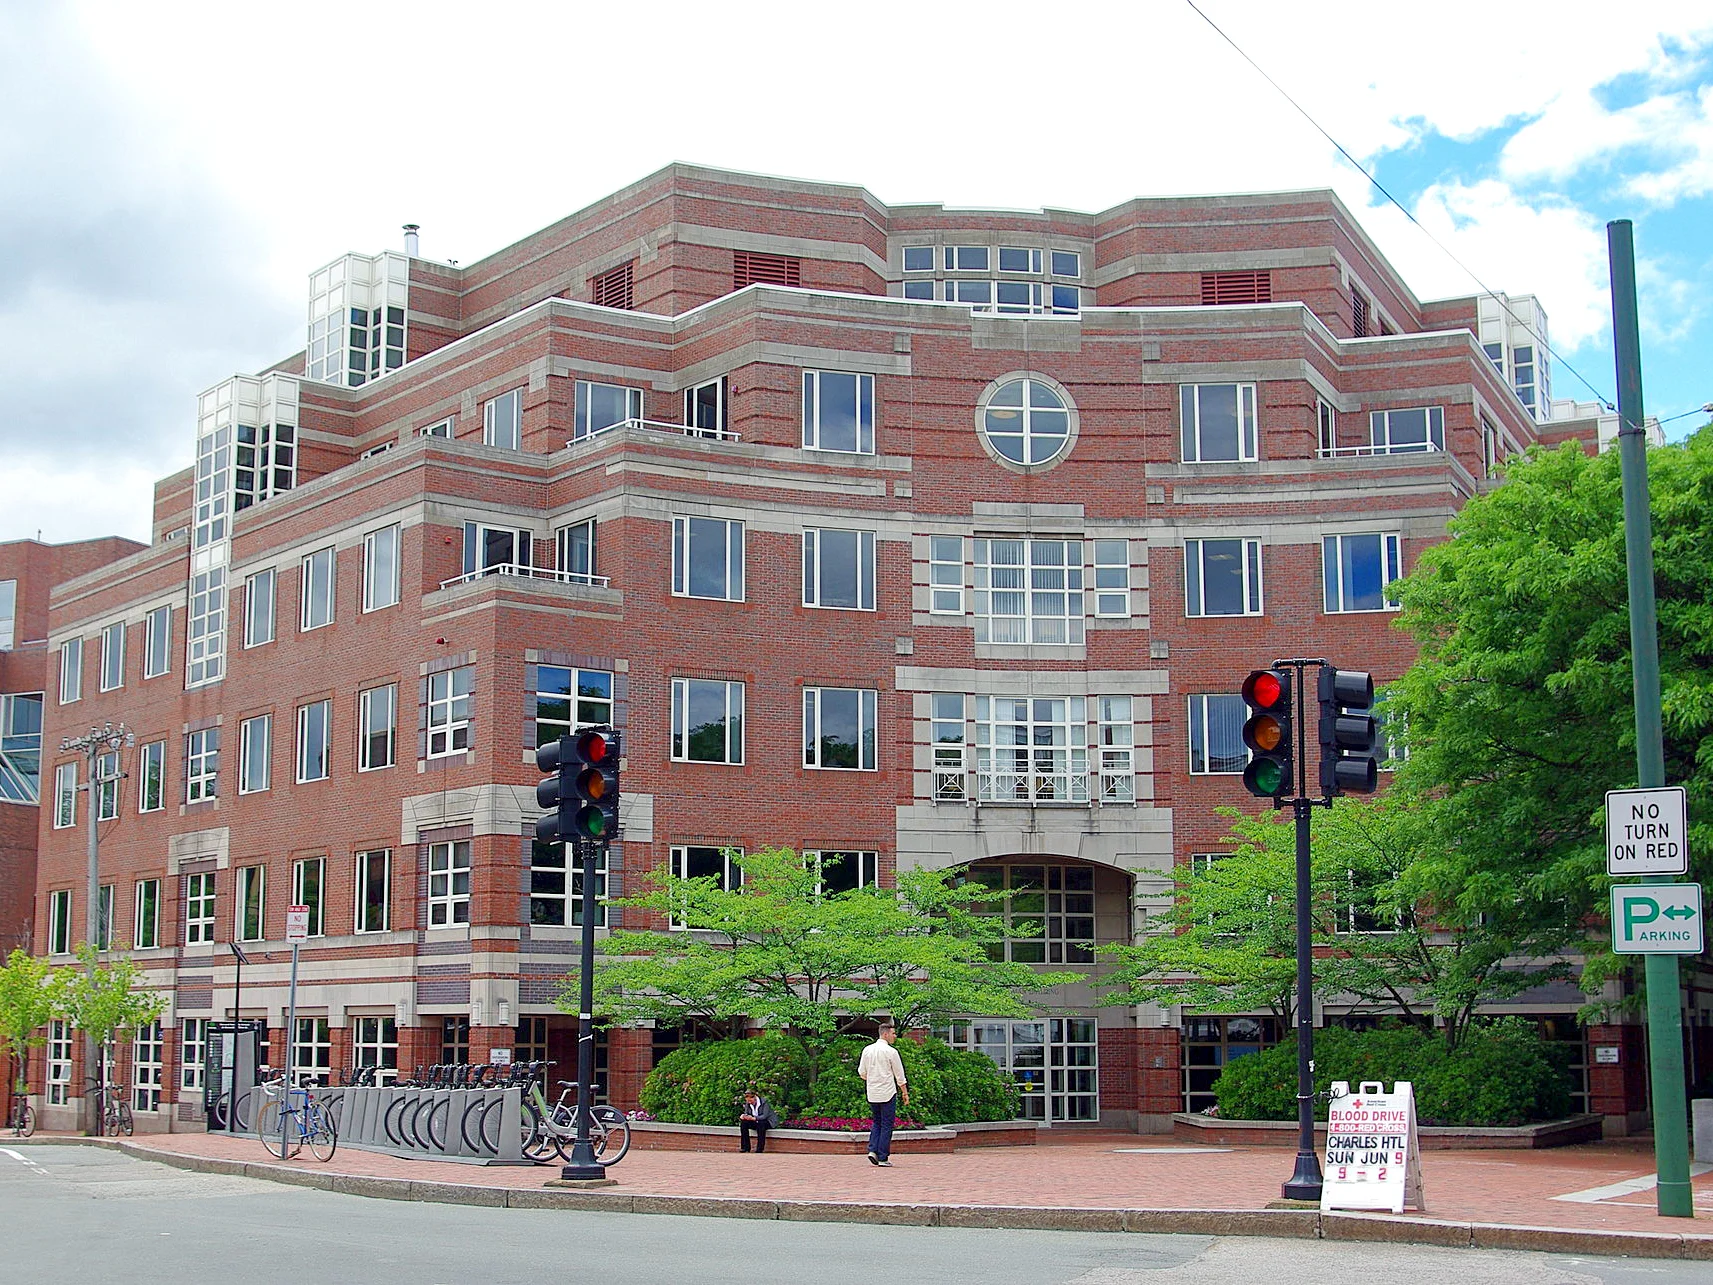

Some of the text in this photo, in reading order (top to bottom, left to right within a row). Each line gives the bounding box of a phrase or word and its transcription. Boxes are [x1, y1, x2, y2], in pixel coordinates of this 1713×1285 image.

[1632, 804, 1659, 820] NO
[1625, 823, 1669, 840] TURN
[1614, 842, 1678, 860] ON RED
[1331, 1111, 1406, 1120] BLOOD DRIVE
[1328, 1136, 1405, 1148] CHARLES HTL
[1327, 1151, 1403, 1165] SUN JUN 9
[1338, 1167, 1347, 1179] 9
[1378, 1167, 1387, 1180] 2
